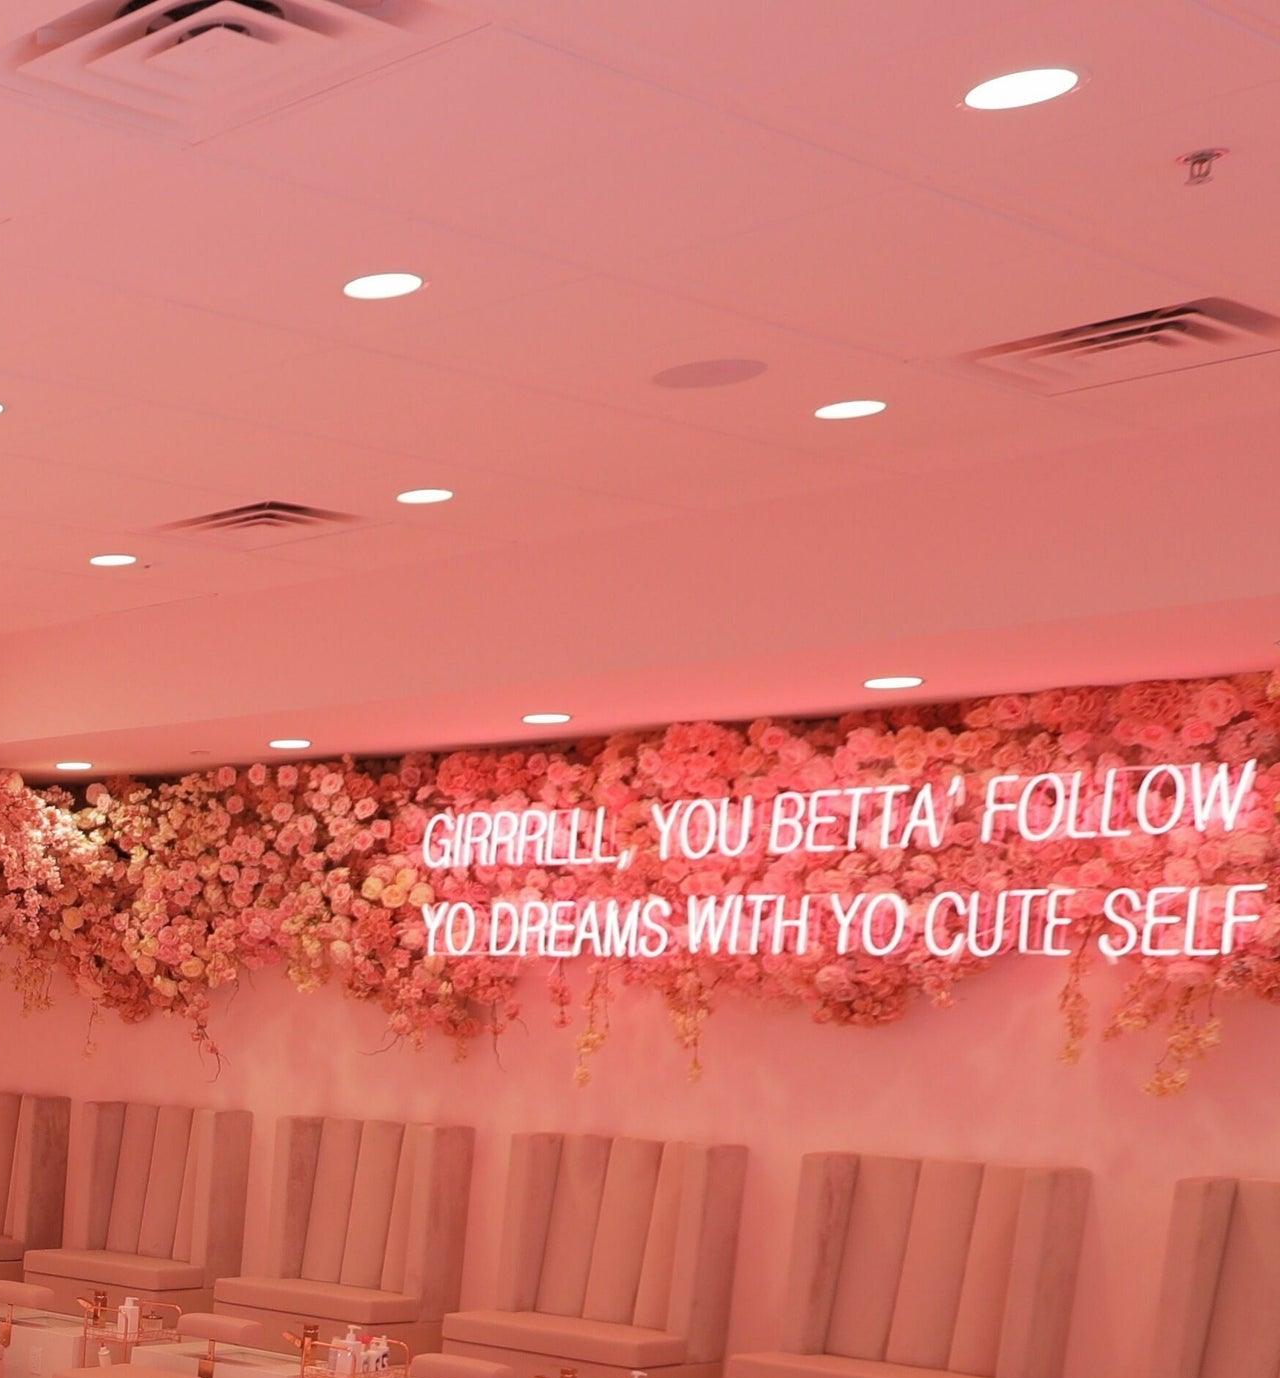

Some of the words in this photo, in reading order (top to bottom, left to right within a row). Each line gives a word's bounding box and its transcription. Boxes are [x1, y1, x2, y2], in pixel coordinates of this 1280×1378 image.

[422, 805, 634, 870] GIRRRLLL,
[650, 797, 754, 861] YOU
[980, 758, 1258, 844] FOLLOW
[421, 901, 476, 957] YO
[490, 899, 672, 959] DREAMS
[687, 893, 812, 956] WITH
[830, 893, 907, 957] YO
[924, 889, 1077, 958] CUTE
[1097, 882, 1269, 958] SELF
